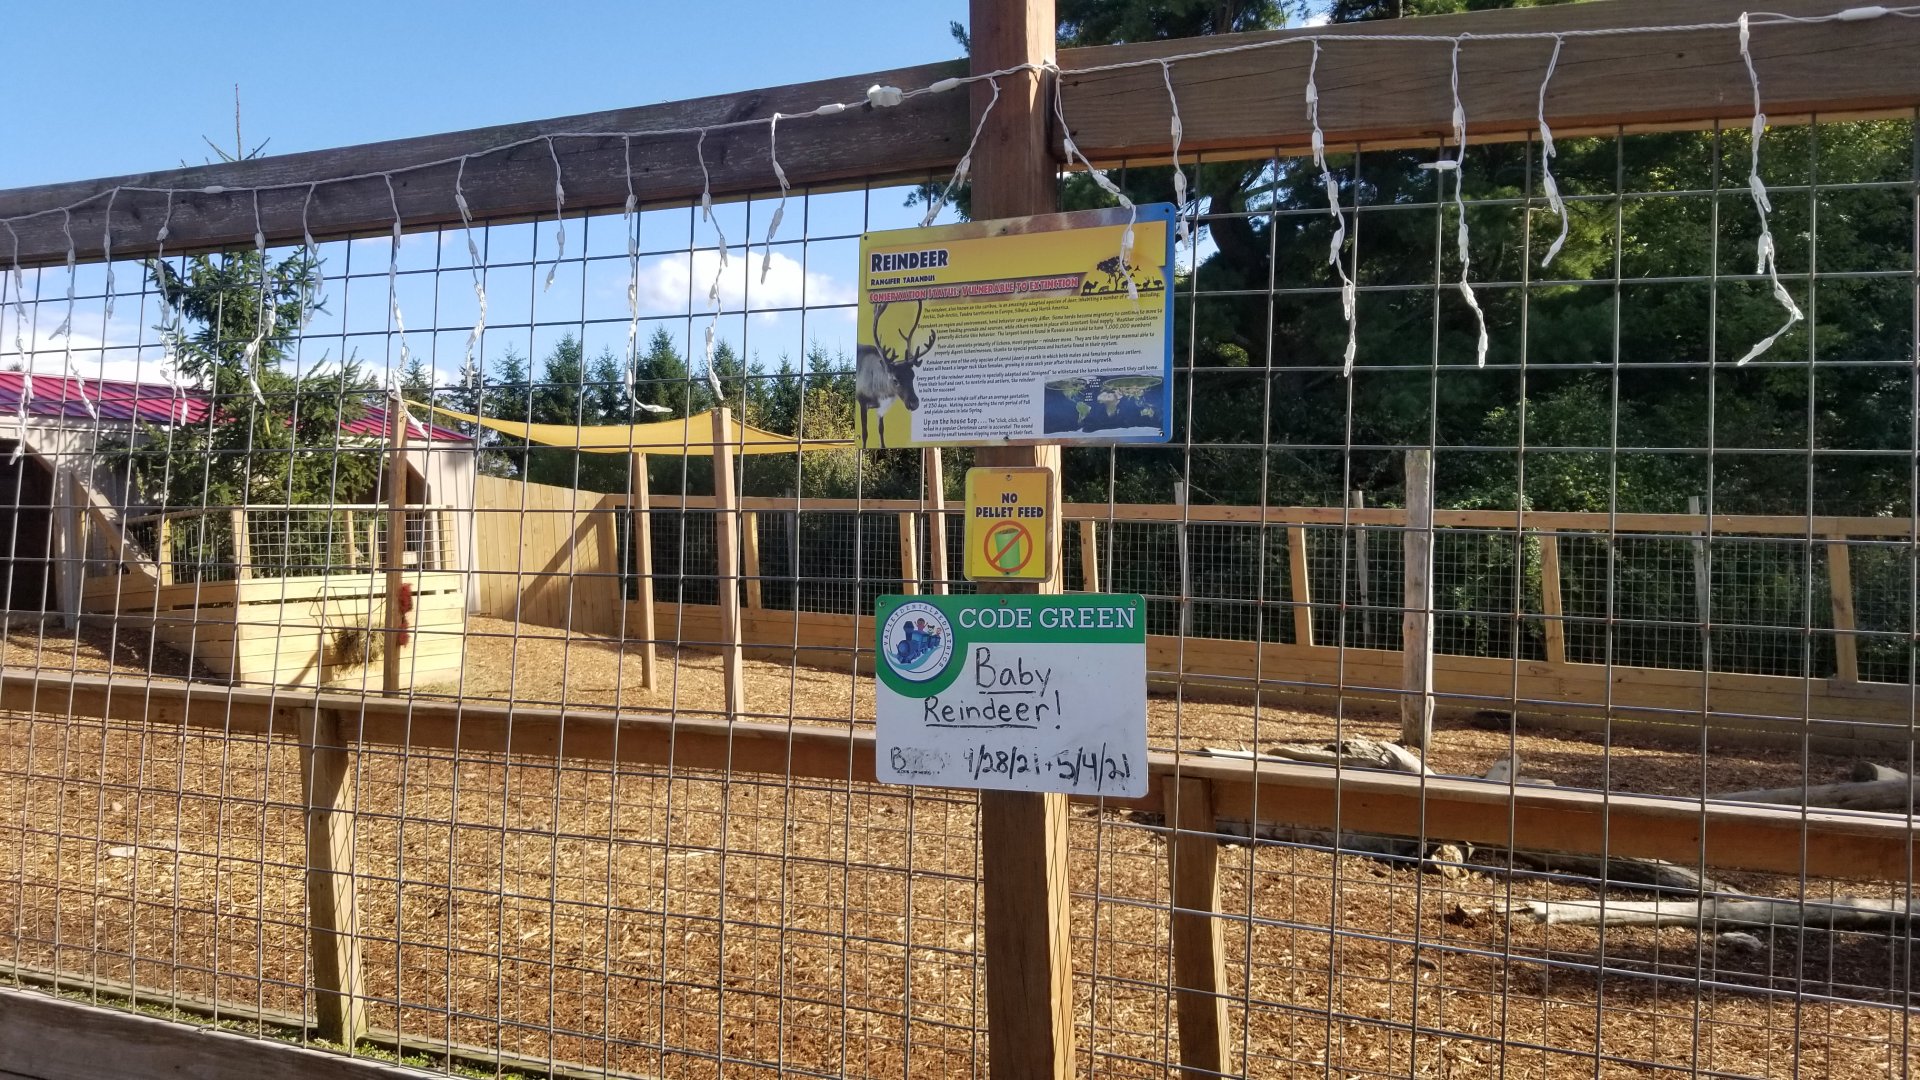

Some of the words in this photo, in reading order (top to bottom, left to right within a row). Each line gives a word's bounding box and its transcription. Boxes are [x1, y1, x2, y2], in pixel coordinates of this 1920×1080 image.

[871, 249, 949, 272] REINDEER
[870, 289, 926, 302] CONSERVATION
[928, 287, 960, 299] STATUS:
[962, 284, 1015, 296] VULNERABLE
[1016, 282, 1028, 292] TO
[1029, 277, 1079, 290] EXTINCTION
[871, 277, 901, 286] RANGIFER
[903, 275, 936, 284] TARANDUS
[1002, 492, 1018, 504] NO
[976, 506, 1014, 518] PELLET
[1018, 506, 1044, 518] FEED
[958, 608, 1032, 628] CODE
[1039, 607, 1136, 628] GREEN
[976, 646, 1052, 697] Baby
[924, 689, 1061, 729] Reindeer!
